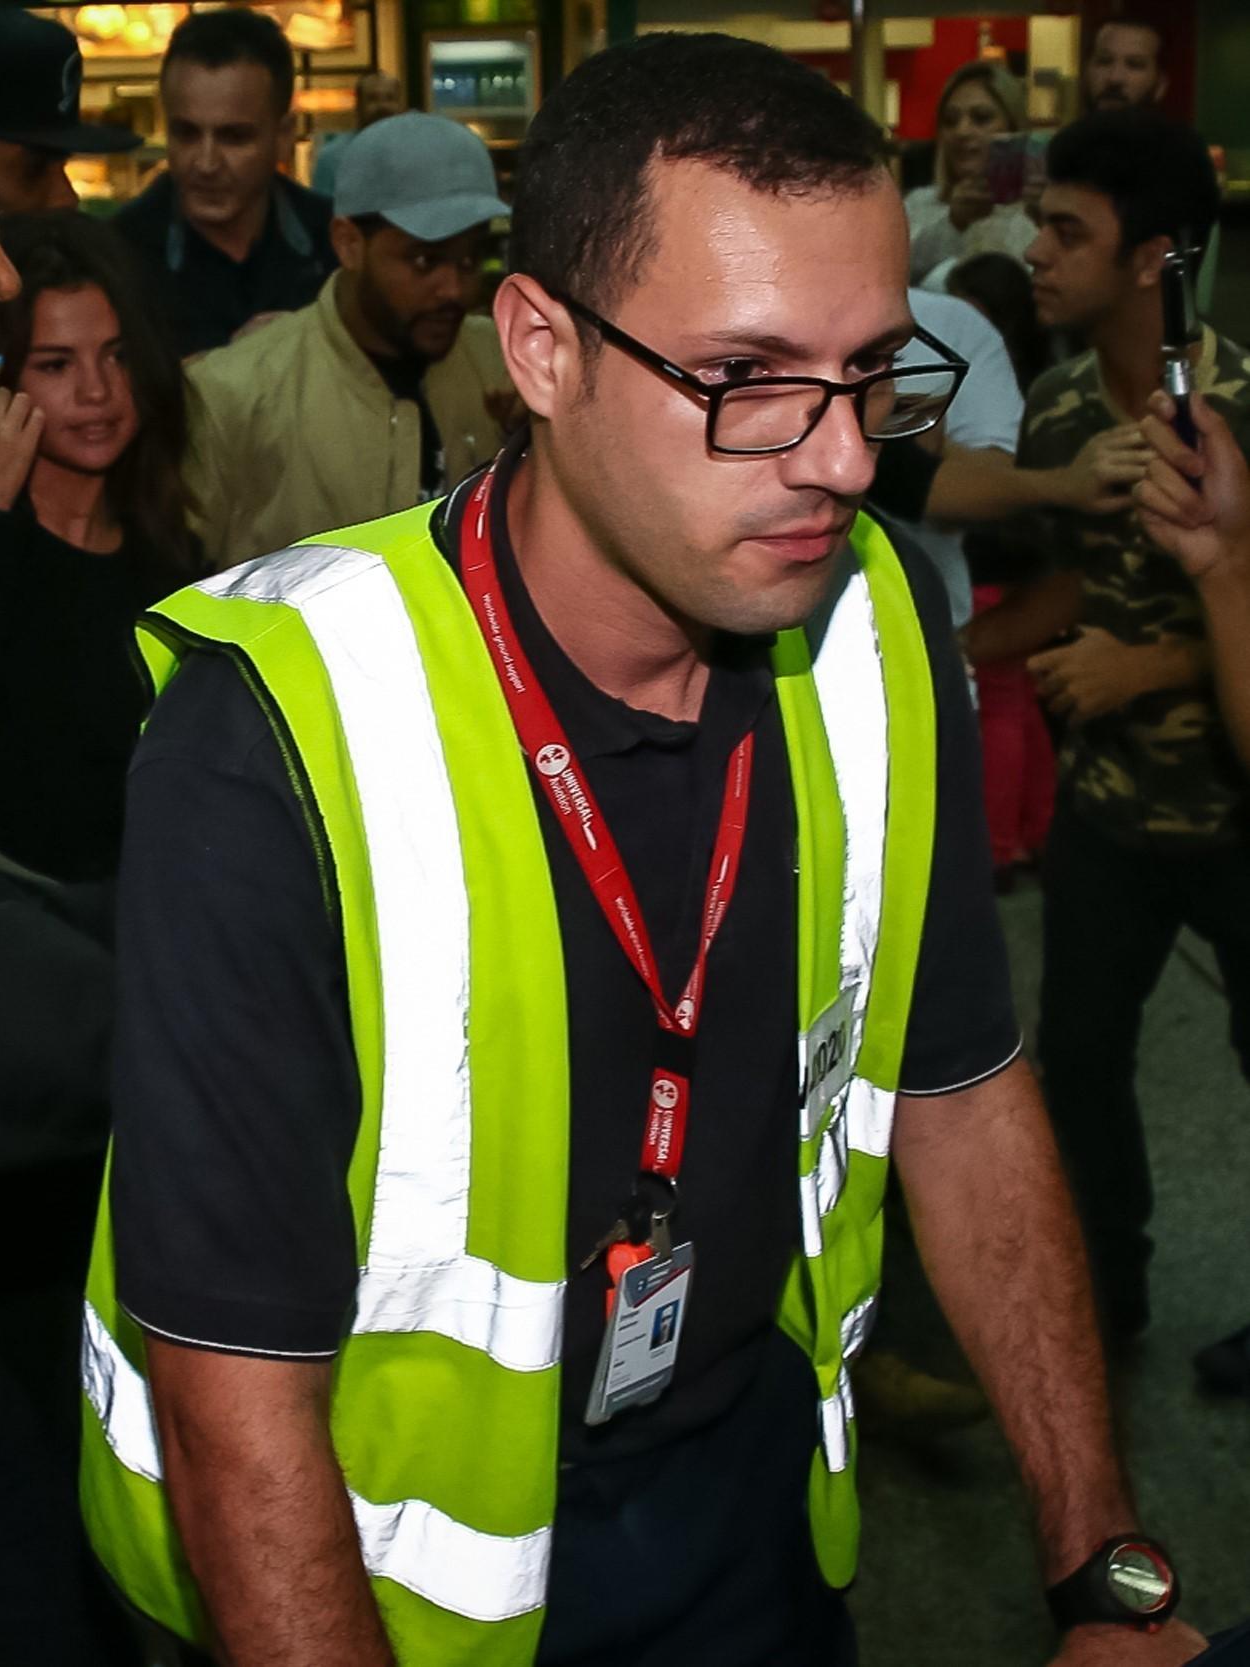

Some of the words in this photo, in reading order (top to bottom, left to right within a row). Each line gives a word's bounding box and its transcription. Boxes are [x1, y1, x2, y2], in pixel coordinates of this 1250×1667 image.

[492, 634, 514, 664] ground
[505, 663, 526, 694] support
[549, 776, 573, 816] Aviation
[561, 767, 594, 823] UNIVERSAL
